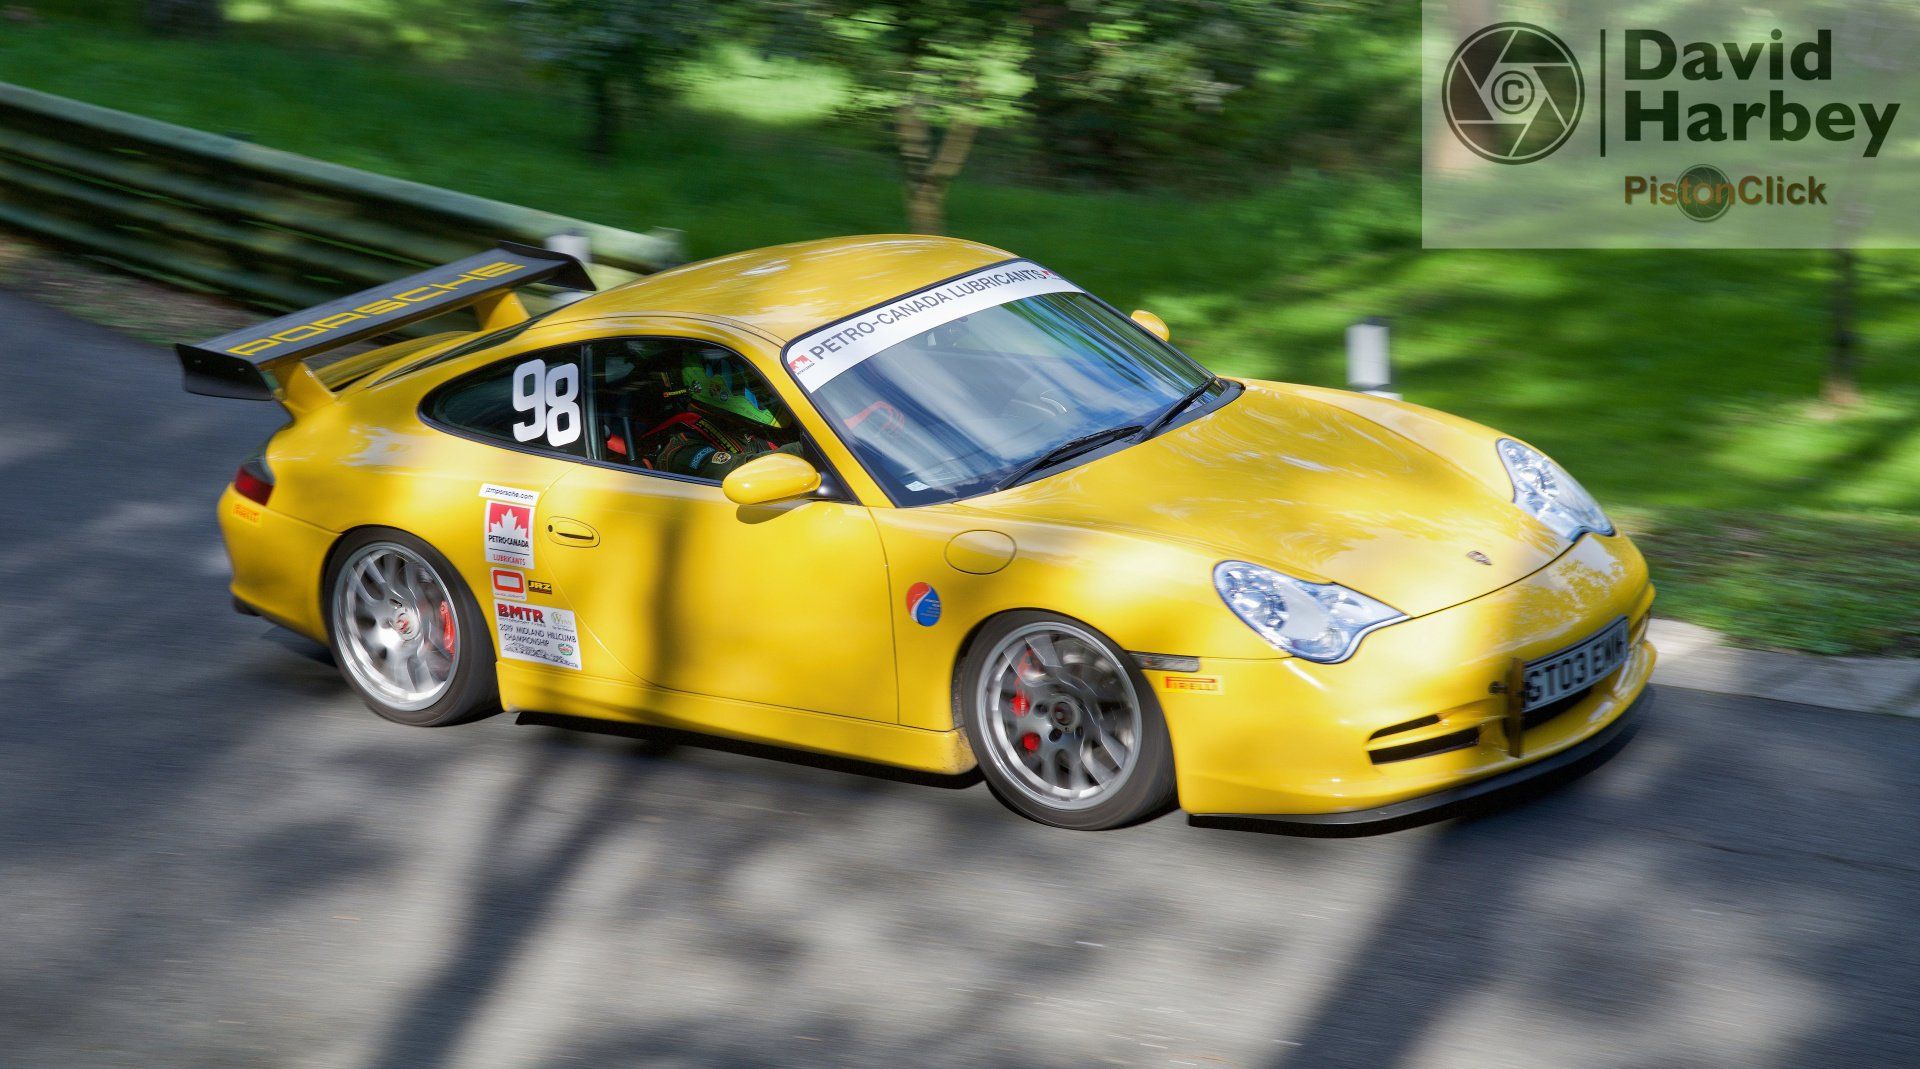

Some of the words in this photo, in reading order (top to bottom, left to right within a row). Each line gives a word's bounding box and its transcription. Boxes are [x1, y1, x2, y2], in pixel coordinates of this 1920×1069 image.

[226, 261, 527, 356] PORSCHE
[809, 292, 953, 360] PETRO-CANADA
[948, 269, 1047, 299] LUBRICANTS
[512, 358, 582, 447] 98
[493, 554, 526, 565] LUBRICANTS
[497, 603, 544, 623] BMTR
[504, 633, 549, 647] CHAMPIONSHIP
[516, 625, 544, 638] MIDLAND
[547, 631, 576, 643] HILLCLIMB
